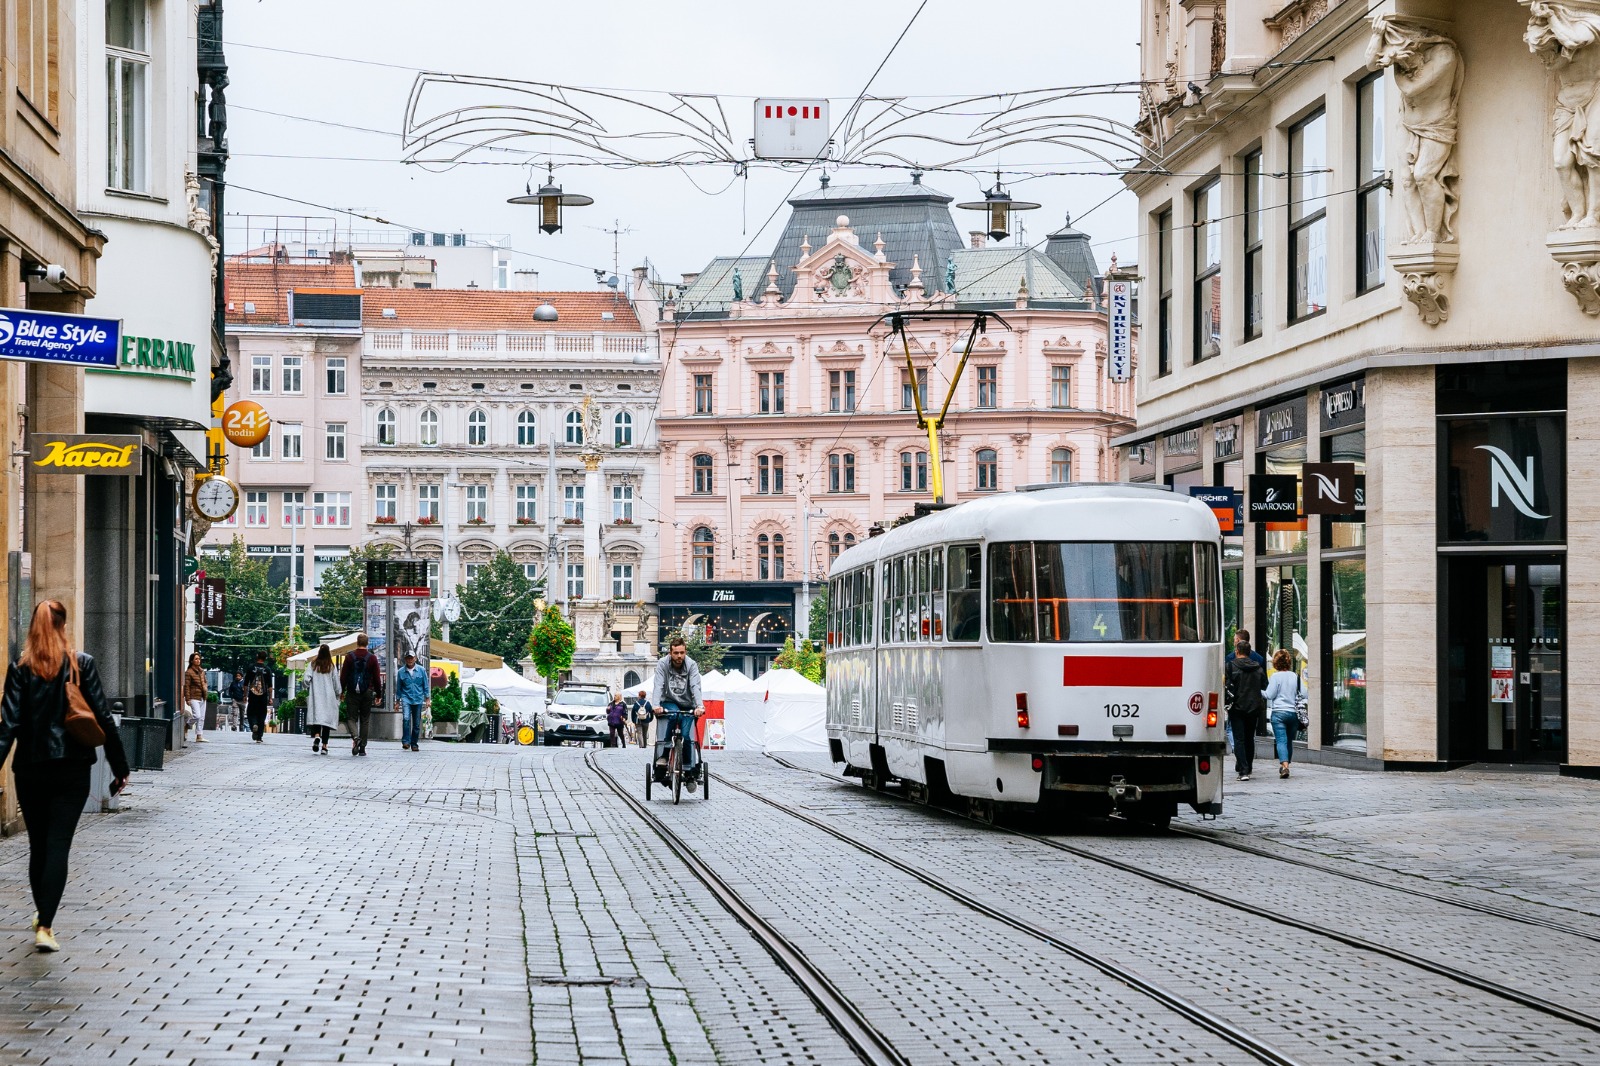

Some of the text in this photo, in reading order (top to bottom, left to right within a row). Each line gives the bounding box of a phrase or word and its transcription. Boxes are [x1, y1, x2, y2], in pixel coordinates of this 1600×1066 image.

[14, 337, 74, 352] Travel Agency
[16, 319, 107, 346] Blue Style
[1113, 295, 1127, 374] KNIHKUPECTVÍ
[1326, 390, 1353, 419] NESPRESSO
[227, 410, 256, 429] 24
[228, 429, 255, 437] hodin
[34, 441, 133, 468] Karat
[1251, 502, 1295, 511] SWAROVSKI
[206, 584, 214, 619] restaurant
[1093, 613, 1107, 637] 4
[1103, 703, 1140, 718] 1032
